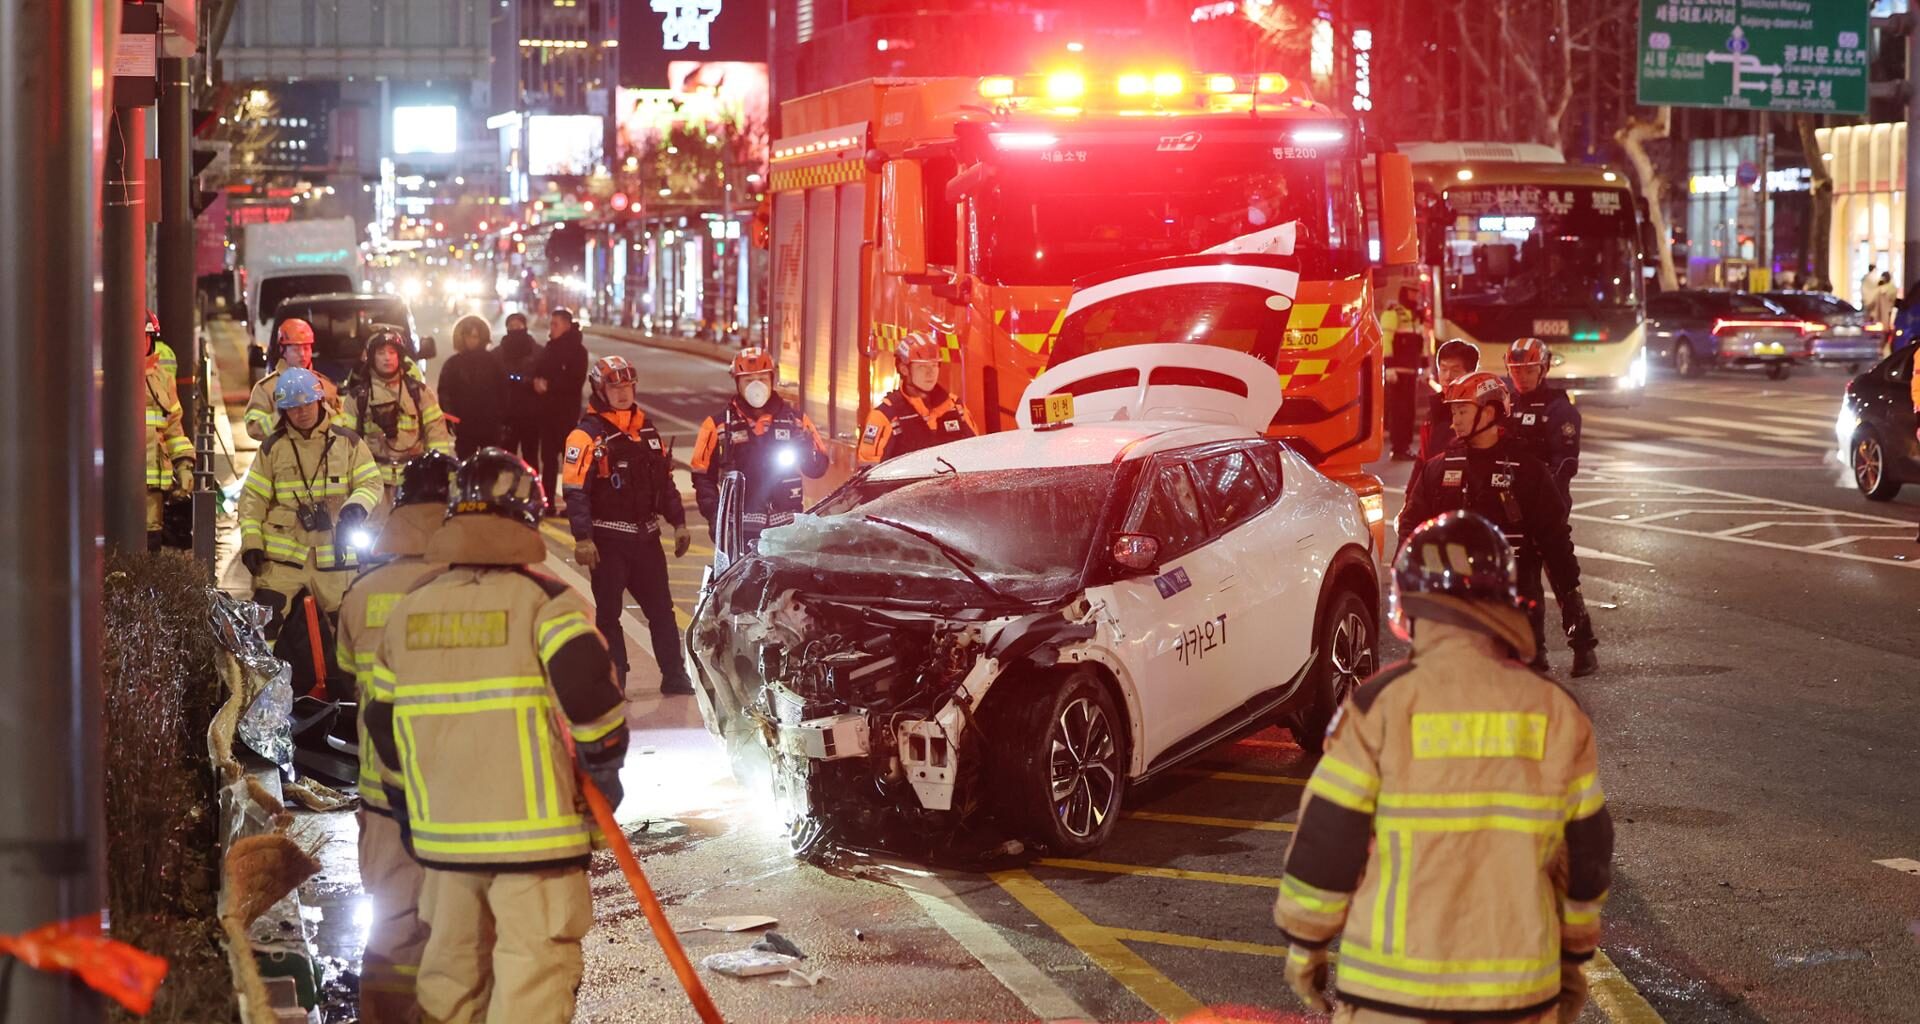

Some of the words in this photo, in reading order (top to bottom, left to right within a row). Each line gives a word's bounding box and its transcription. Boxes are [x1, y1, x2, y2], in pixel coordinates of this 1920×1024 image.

[1784, 45, 1829, 64] 광화문
[1771, 78, 1832, 97] 종로구청
[1040, 149, 1087, 163] 서울소방
[1273, 147, 1317, 160] 종로200
[1052, 398, 1069, 417] 인천
[1175, 613, 1227, 666] 카카오T
